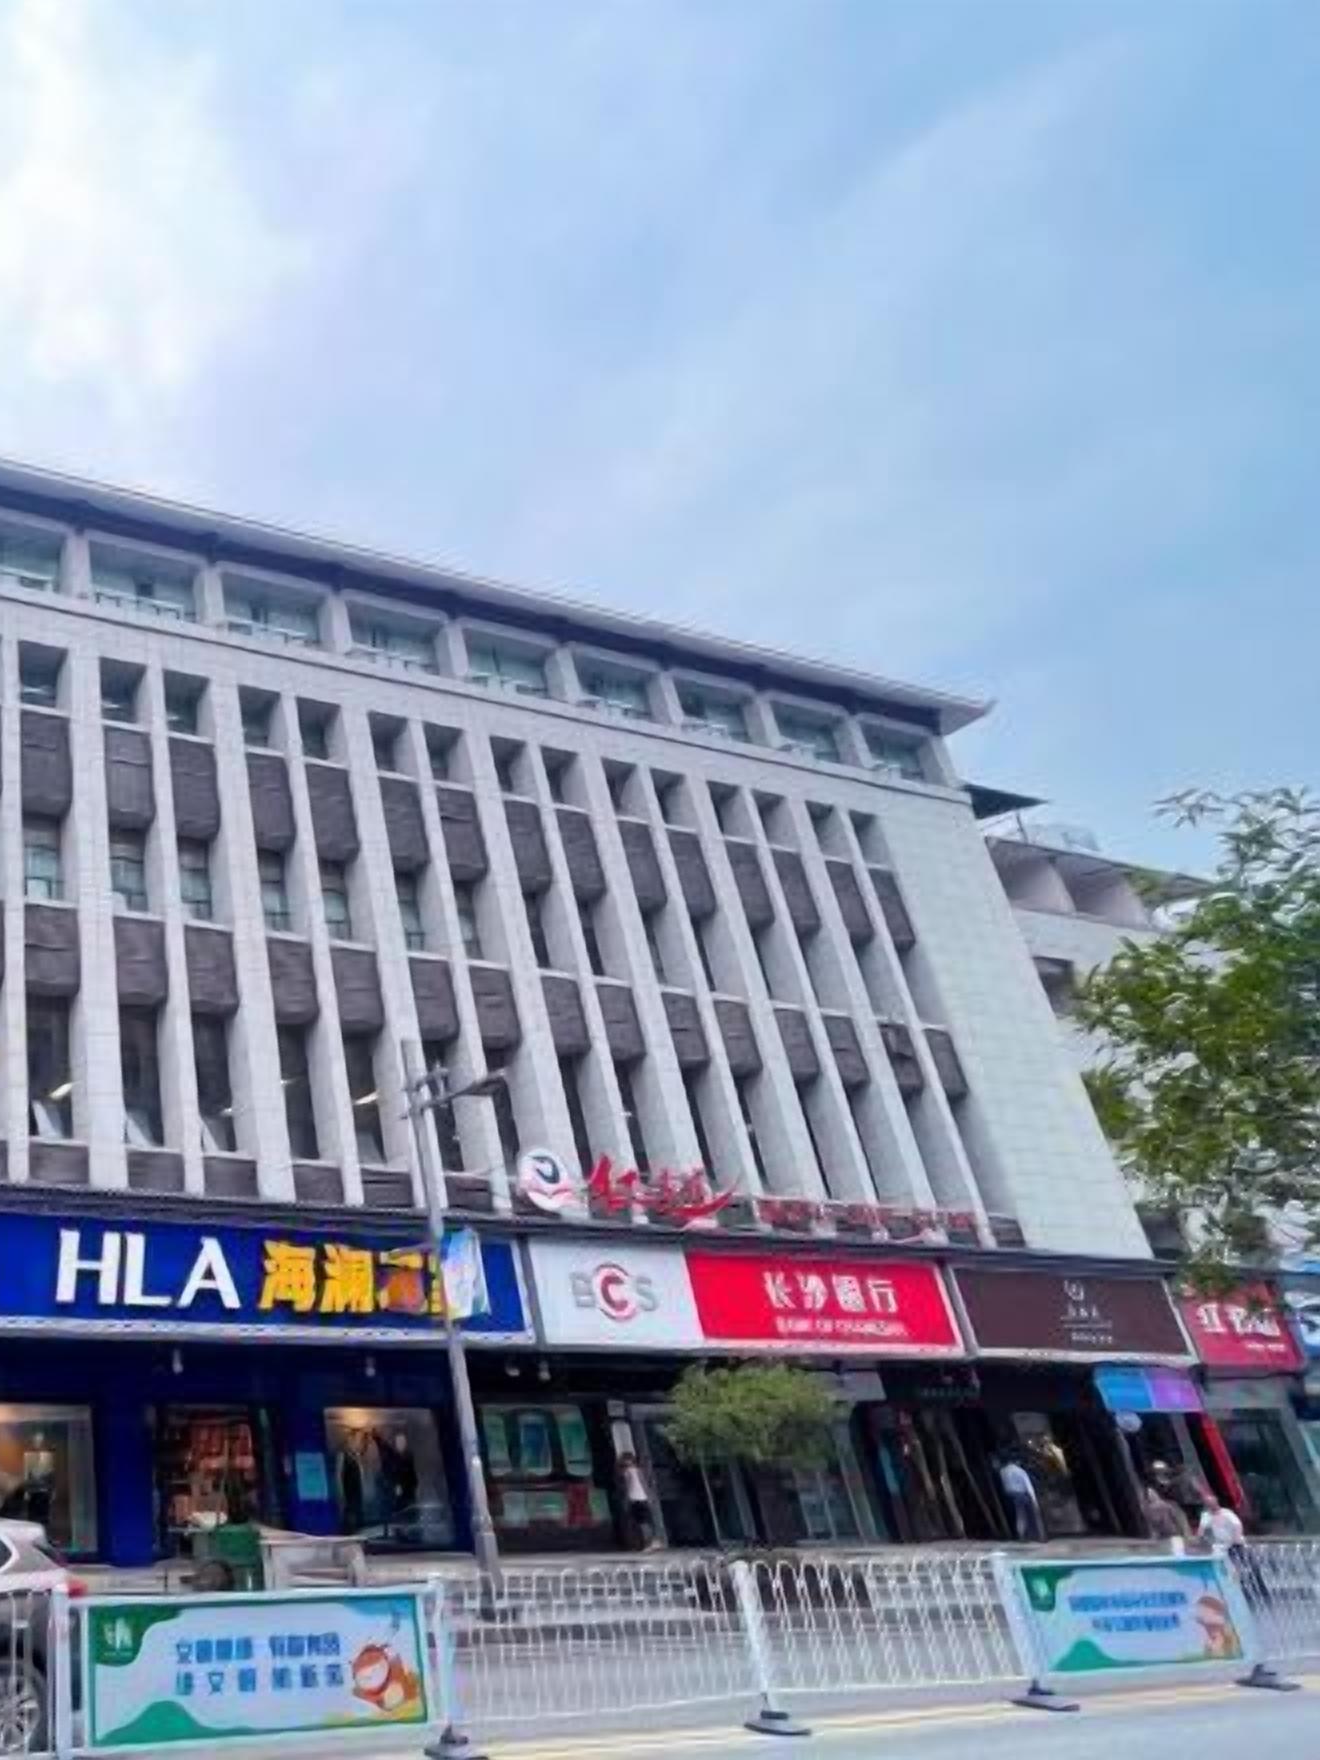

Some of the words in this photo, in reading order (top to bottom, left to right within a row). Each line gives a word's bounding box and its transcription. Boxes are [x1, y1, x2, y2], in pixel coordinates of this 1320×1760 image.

[55, 1229, 240, 1309] HLA
[258, 1240, 446, 1314] 海澜
[568, 1263, 660, 1323] BCS
[763, 1271, 899, 1313] 长沙银行
